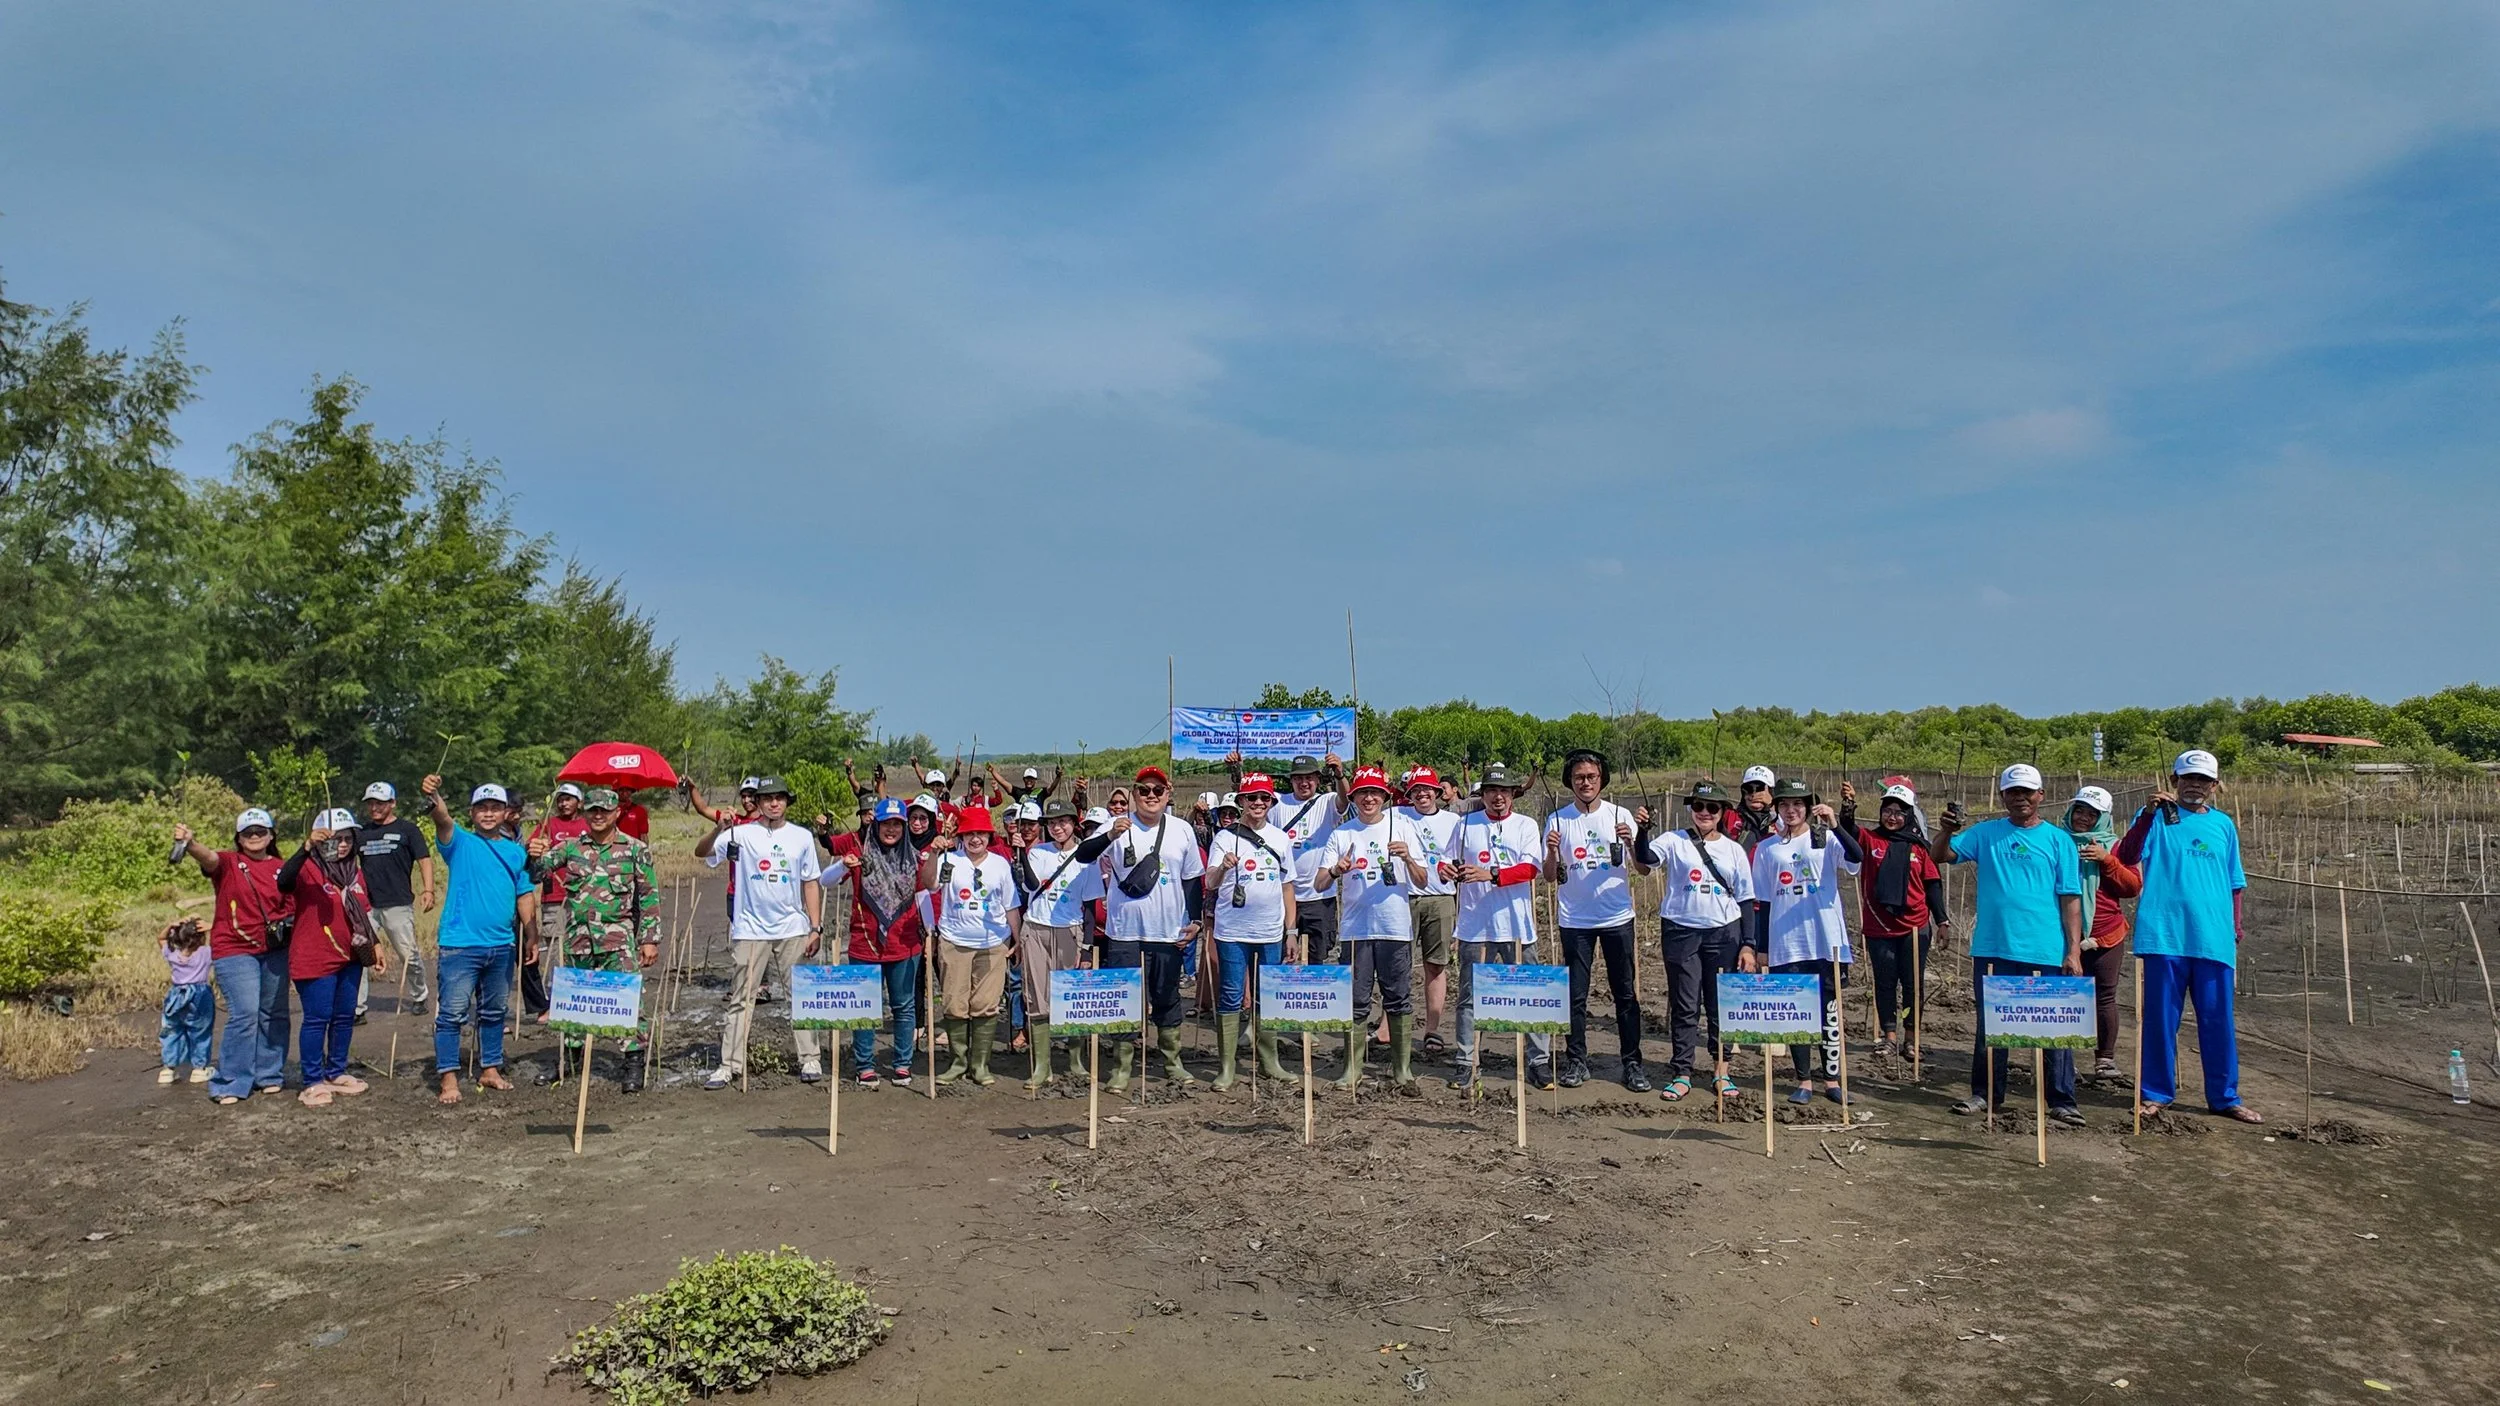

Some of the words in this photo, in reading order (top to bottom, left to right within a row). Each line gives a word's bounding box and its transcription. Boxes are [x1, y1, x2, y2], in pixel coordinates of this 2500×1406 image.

[2003, 852, 2032, 860] TERA
[2185, 848, 2216, 860] TERA
[571, 994, 618, 1006] MANDIRI
[816, 991, 857, 1000] PEMDA
[1063, 991, 1128, 1001] EARTHCORE
[1275, 991, 1337, 1000] INDONESIA
[802, 1000, 847, 1009] PABEAN
[850, 1000, 871, 1009] ILIR
[1072, 1000, 1120, 1009] INTRADE
[1284, 1001, 1328, 1010] AIRASIA
[1481, 996, 1516, 1006] EARTH
[1520, 998, 1562, 1008] PLEDGE
[1742, 1001, 1797, 1011] ARUNIKA
[556, 1002, 586, 1013] HIJAU
[590, 1005, 632, 1016] LESTARI
[1066, 1009, 1126, 1019] INDONESIA
[1994, 1005, 2056, 1015] KELOMPOK
[2060, 1006, 2085, 1015] TANI
[1728, 1011, 1760, 1020] BUMI
[1764, 1012, 1812, 1021] LESTARI
[2000, 1014, 2028, 1023] JAYA
[2031, 1015, 2081, 1023] MANDIRI
[1823, 999, 1840, 1075] adidas
